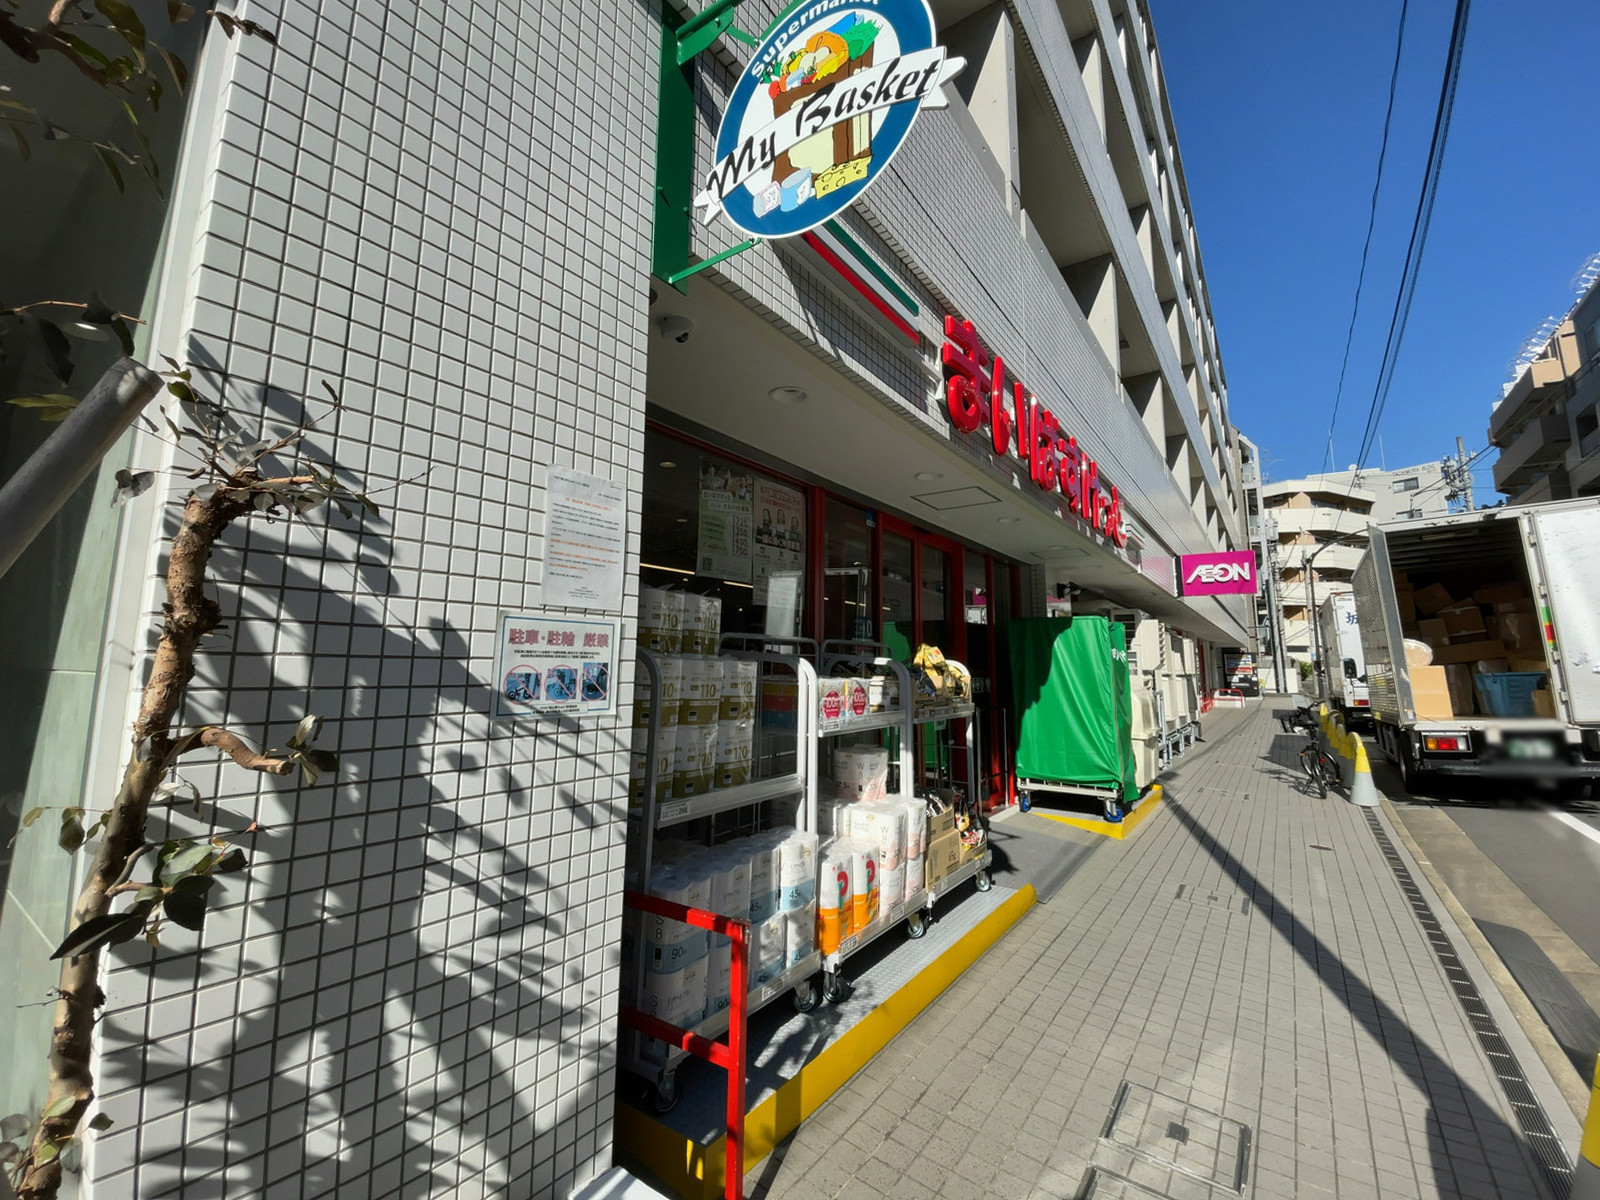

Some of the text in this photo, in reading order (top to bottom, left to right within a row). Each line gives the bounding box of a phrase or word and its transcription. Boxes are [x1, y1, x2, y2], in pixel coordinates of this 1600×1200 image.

[751, 0, 879, 77] Superma
[706, 56, 941, 200] My Basket
[943, 315, 1128, 549] まいばすけっと
[1186, 561, 1251, 584] AEON
[508, 627, 576, 647] 駐車・駐輪
[661, 683, 675, 698] 10
